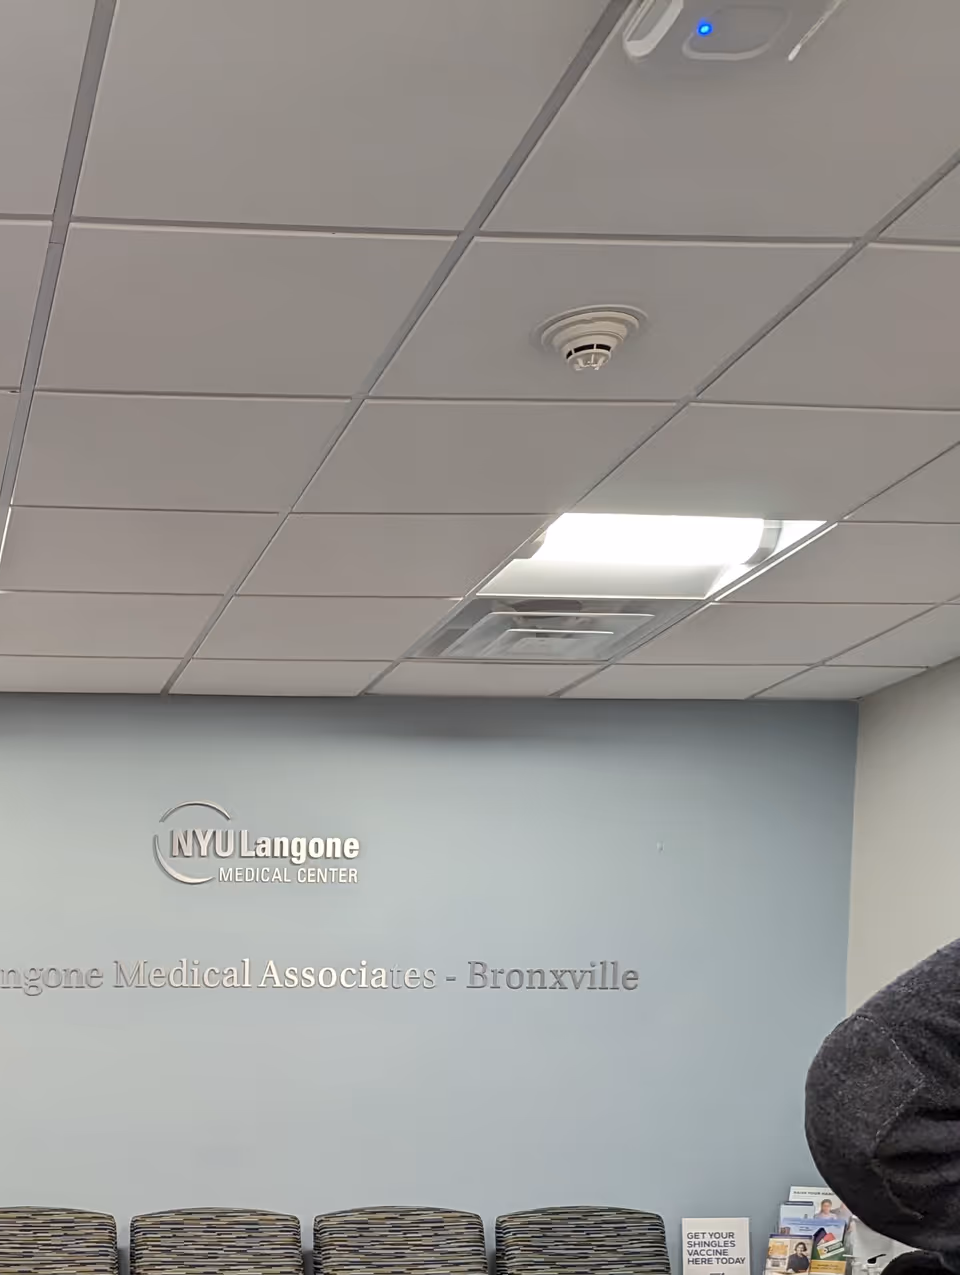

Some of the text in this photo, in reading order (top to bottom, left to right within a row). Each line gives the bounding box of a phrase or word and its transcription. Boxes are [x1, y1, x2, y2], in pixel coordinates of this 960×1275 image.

[171, 829, 360, 865] NYU Langone
[218, 867, 359, 884] MEDICAL CENTER
[112, 957, 253, 989] Medical
[257, 958, 438, 990] Associates
[465, 960, 640, 992] Bronxville
[686, 1231, 735, 1240] GET YOUR
[686, 1240, 736, 1249] SHINGLES
[687, 1248, 729, 1257] VACCINE
[687, 1257, 746, 1265] HERE TODAY
